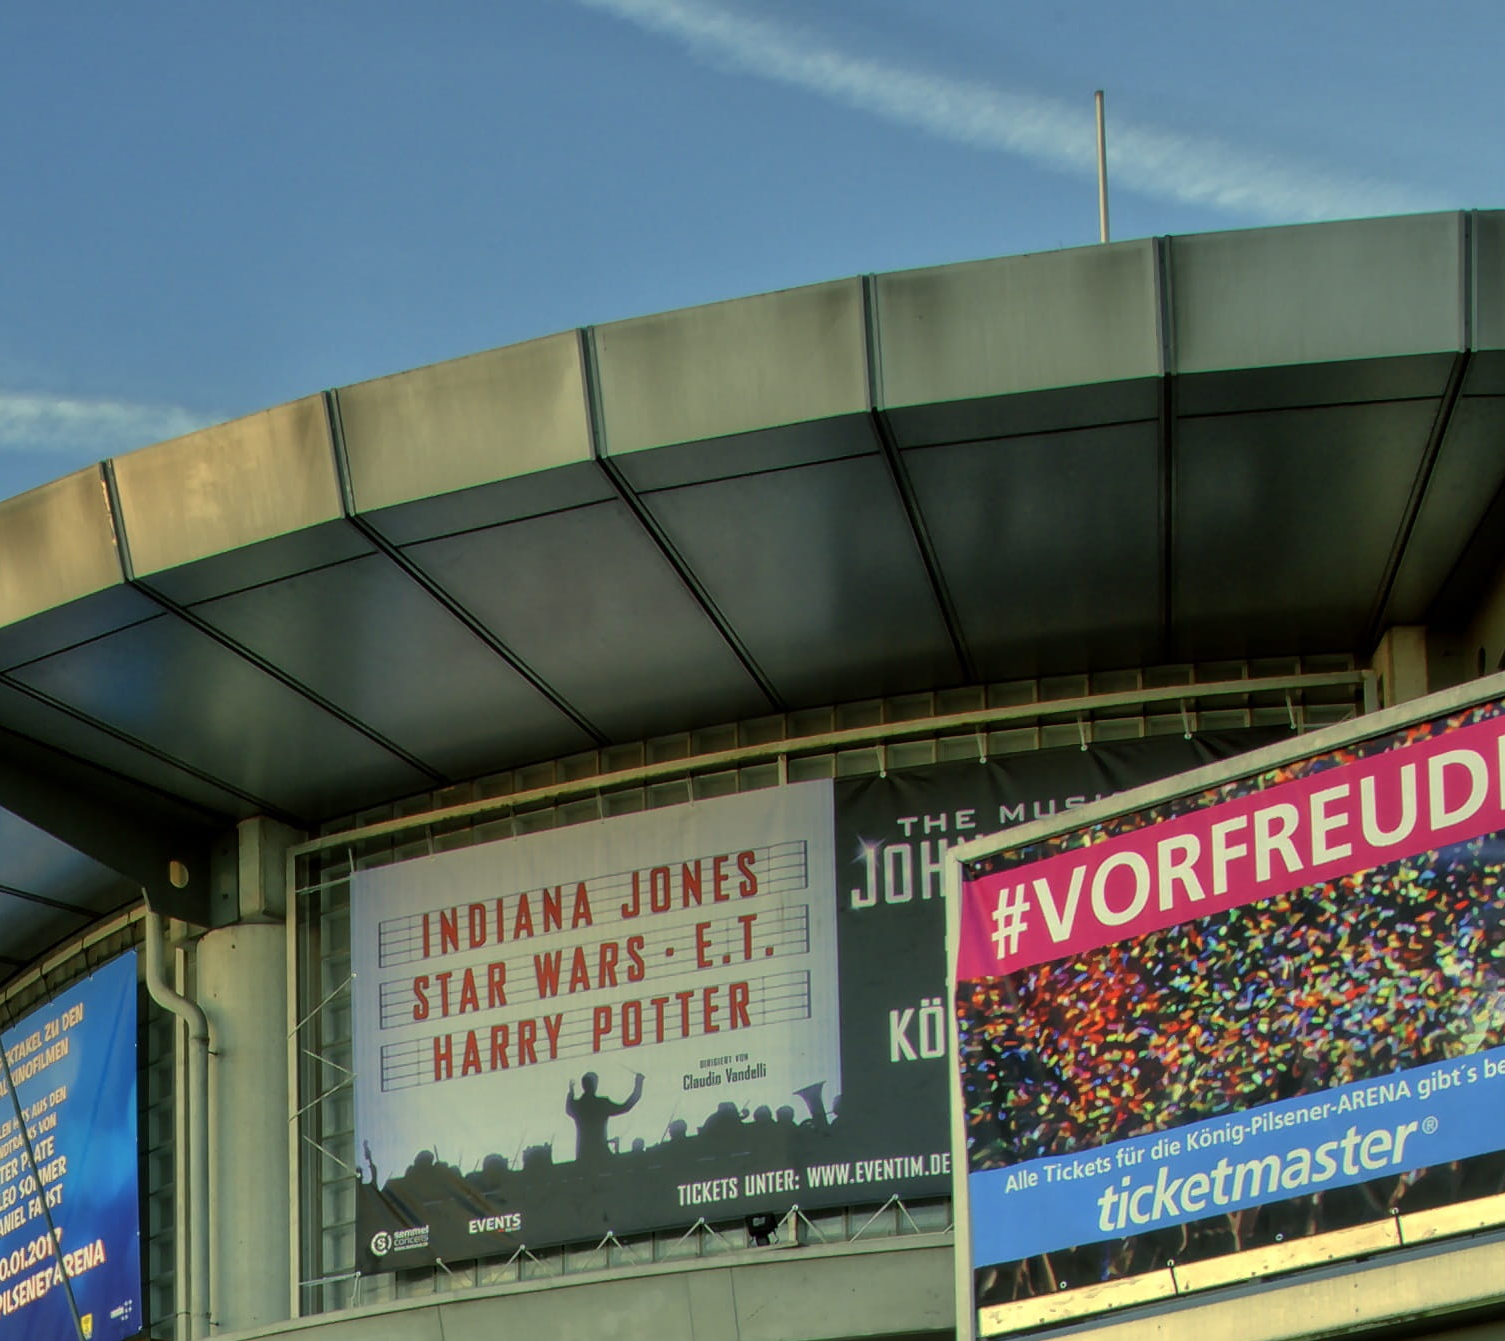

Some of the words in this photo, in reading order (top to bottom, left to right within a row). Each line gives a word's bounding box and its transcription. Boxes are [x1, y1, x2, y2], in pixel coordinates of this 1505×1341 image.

[897, 809, 976, 837] THE
[421, 881, 593, 958] INDIANA
[621, 849, 759, 919] JONES
[413, 961, 508, 1022] STAR
[534, 934, 646, 998] WARS
[696, 914, 775, 968] E.T.
[44, 1018, 59, 1042] ZU
[62, 1002, 84, 1031] DEN
[433, 1014, 564, 1081] HARRY
[593, 980, 753, 1053] POTTER
[683, 1071, 721, 1091] Claudio
[725, 1063, 767, 1084] Vandelli
[31, 1097, 48, 1121] AUS
[49, 1085, 67, 1108] DEN
[39, 1112, 57, 1132] VON
[1005, 1170, 1039, 1195] Alle
[1043, 1156, 1112, 1186] Tickets
[1116, 1144, 1145, 1171] für
[1150, 1136, 1182, 1161] die
[1186, 1082, 1411, 1153] König-Pilsener-ARENA
[678, 1177, 738, 1206] TICKETS
[745, 1168, 800, 1197] UNTER:
[806, 1152, 951, 1188] WWW.EVENTIM.DE
[1097, 1119, 1417, 1233] ticketmaster
[468, 1213, 521, 1234] EVENTS
